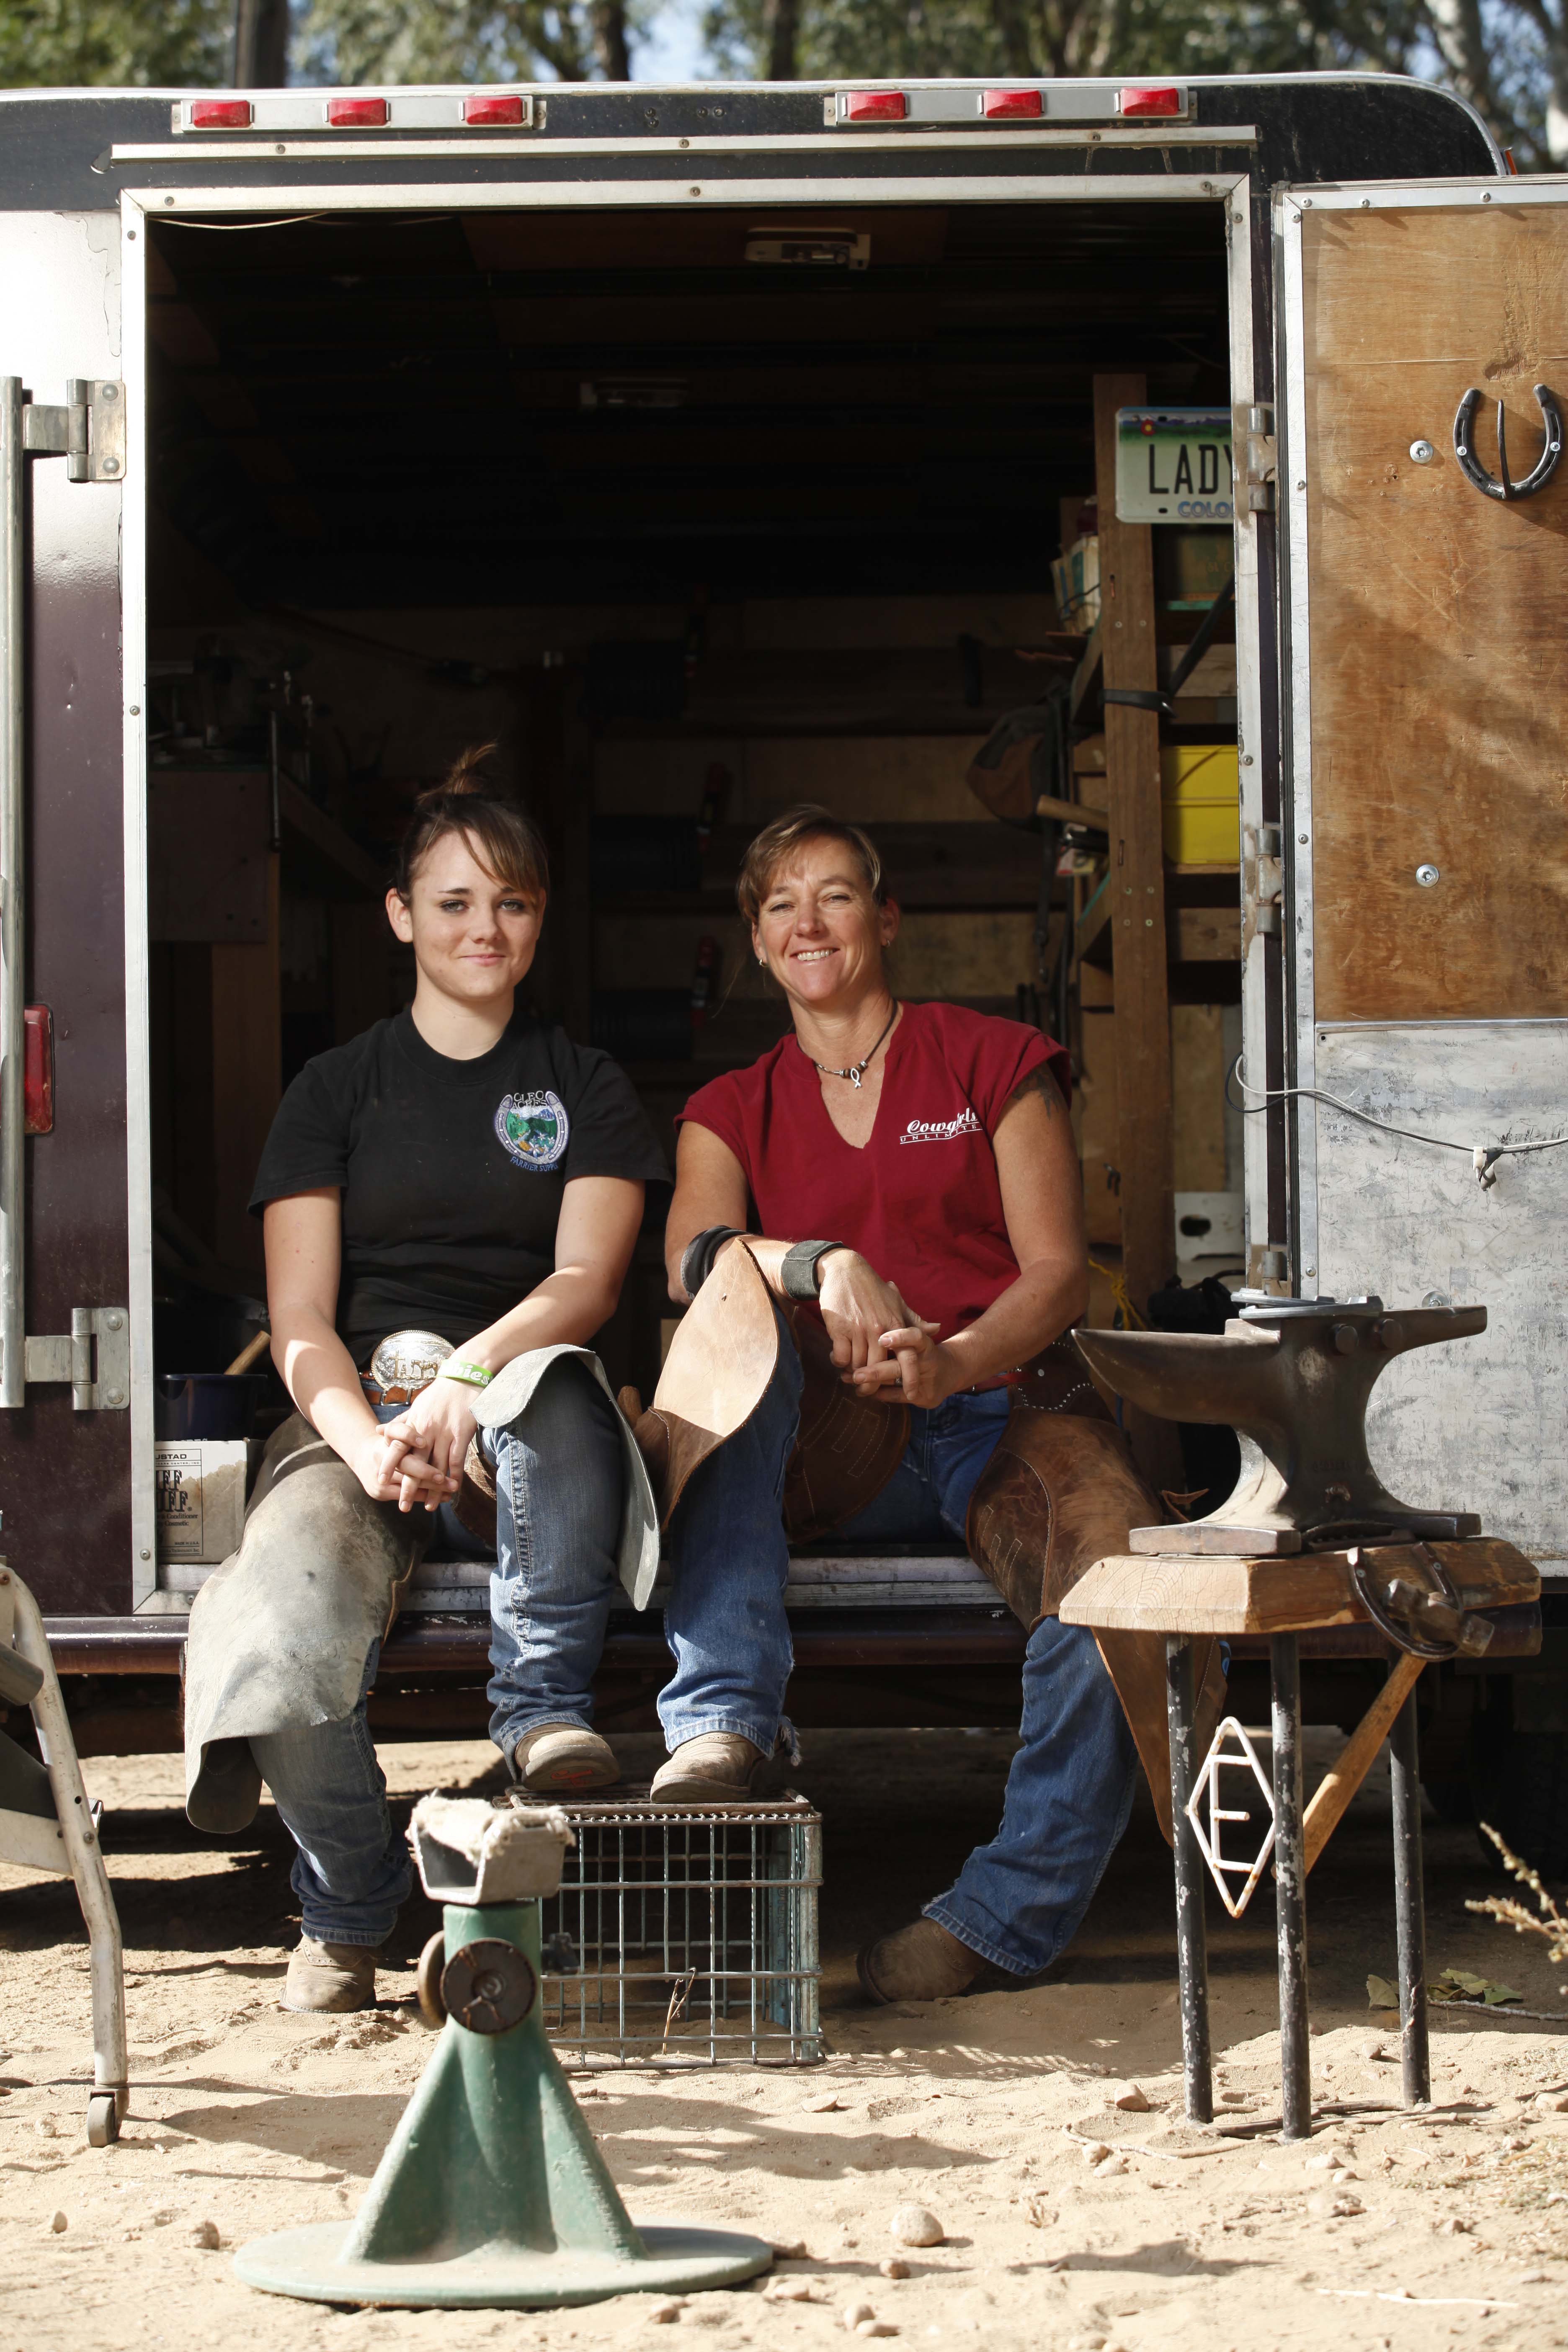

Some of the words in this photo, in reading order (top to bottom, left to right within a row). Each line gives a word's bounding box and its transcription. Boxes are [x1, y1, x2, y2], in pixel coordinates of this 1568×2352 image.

[512, 1099, 547, 1109] ACRES
[514, 1091, 544, 1102] CLEO
[907, 1107, 977, 1134] Cowgirls
[900, 1124, 981, 1142] UNLIMITE
[510, 1156, 538, 1172] FARRIER
